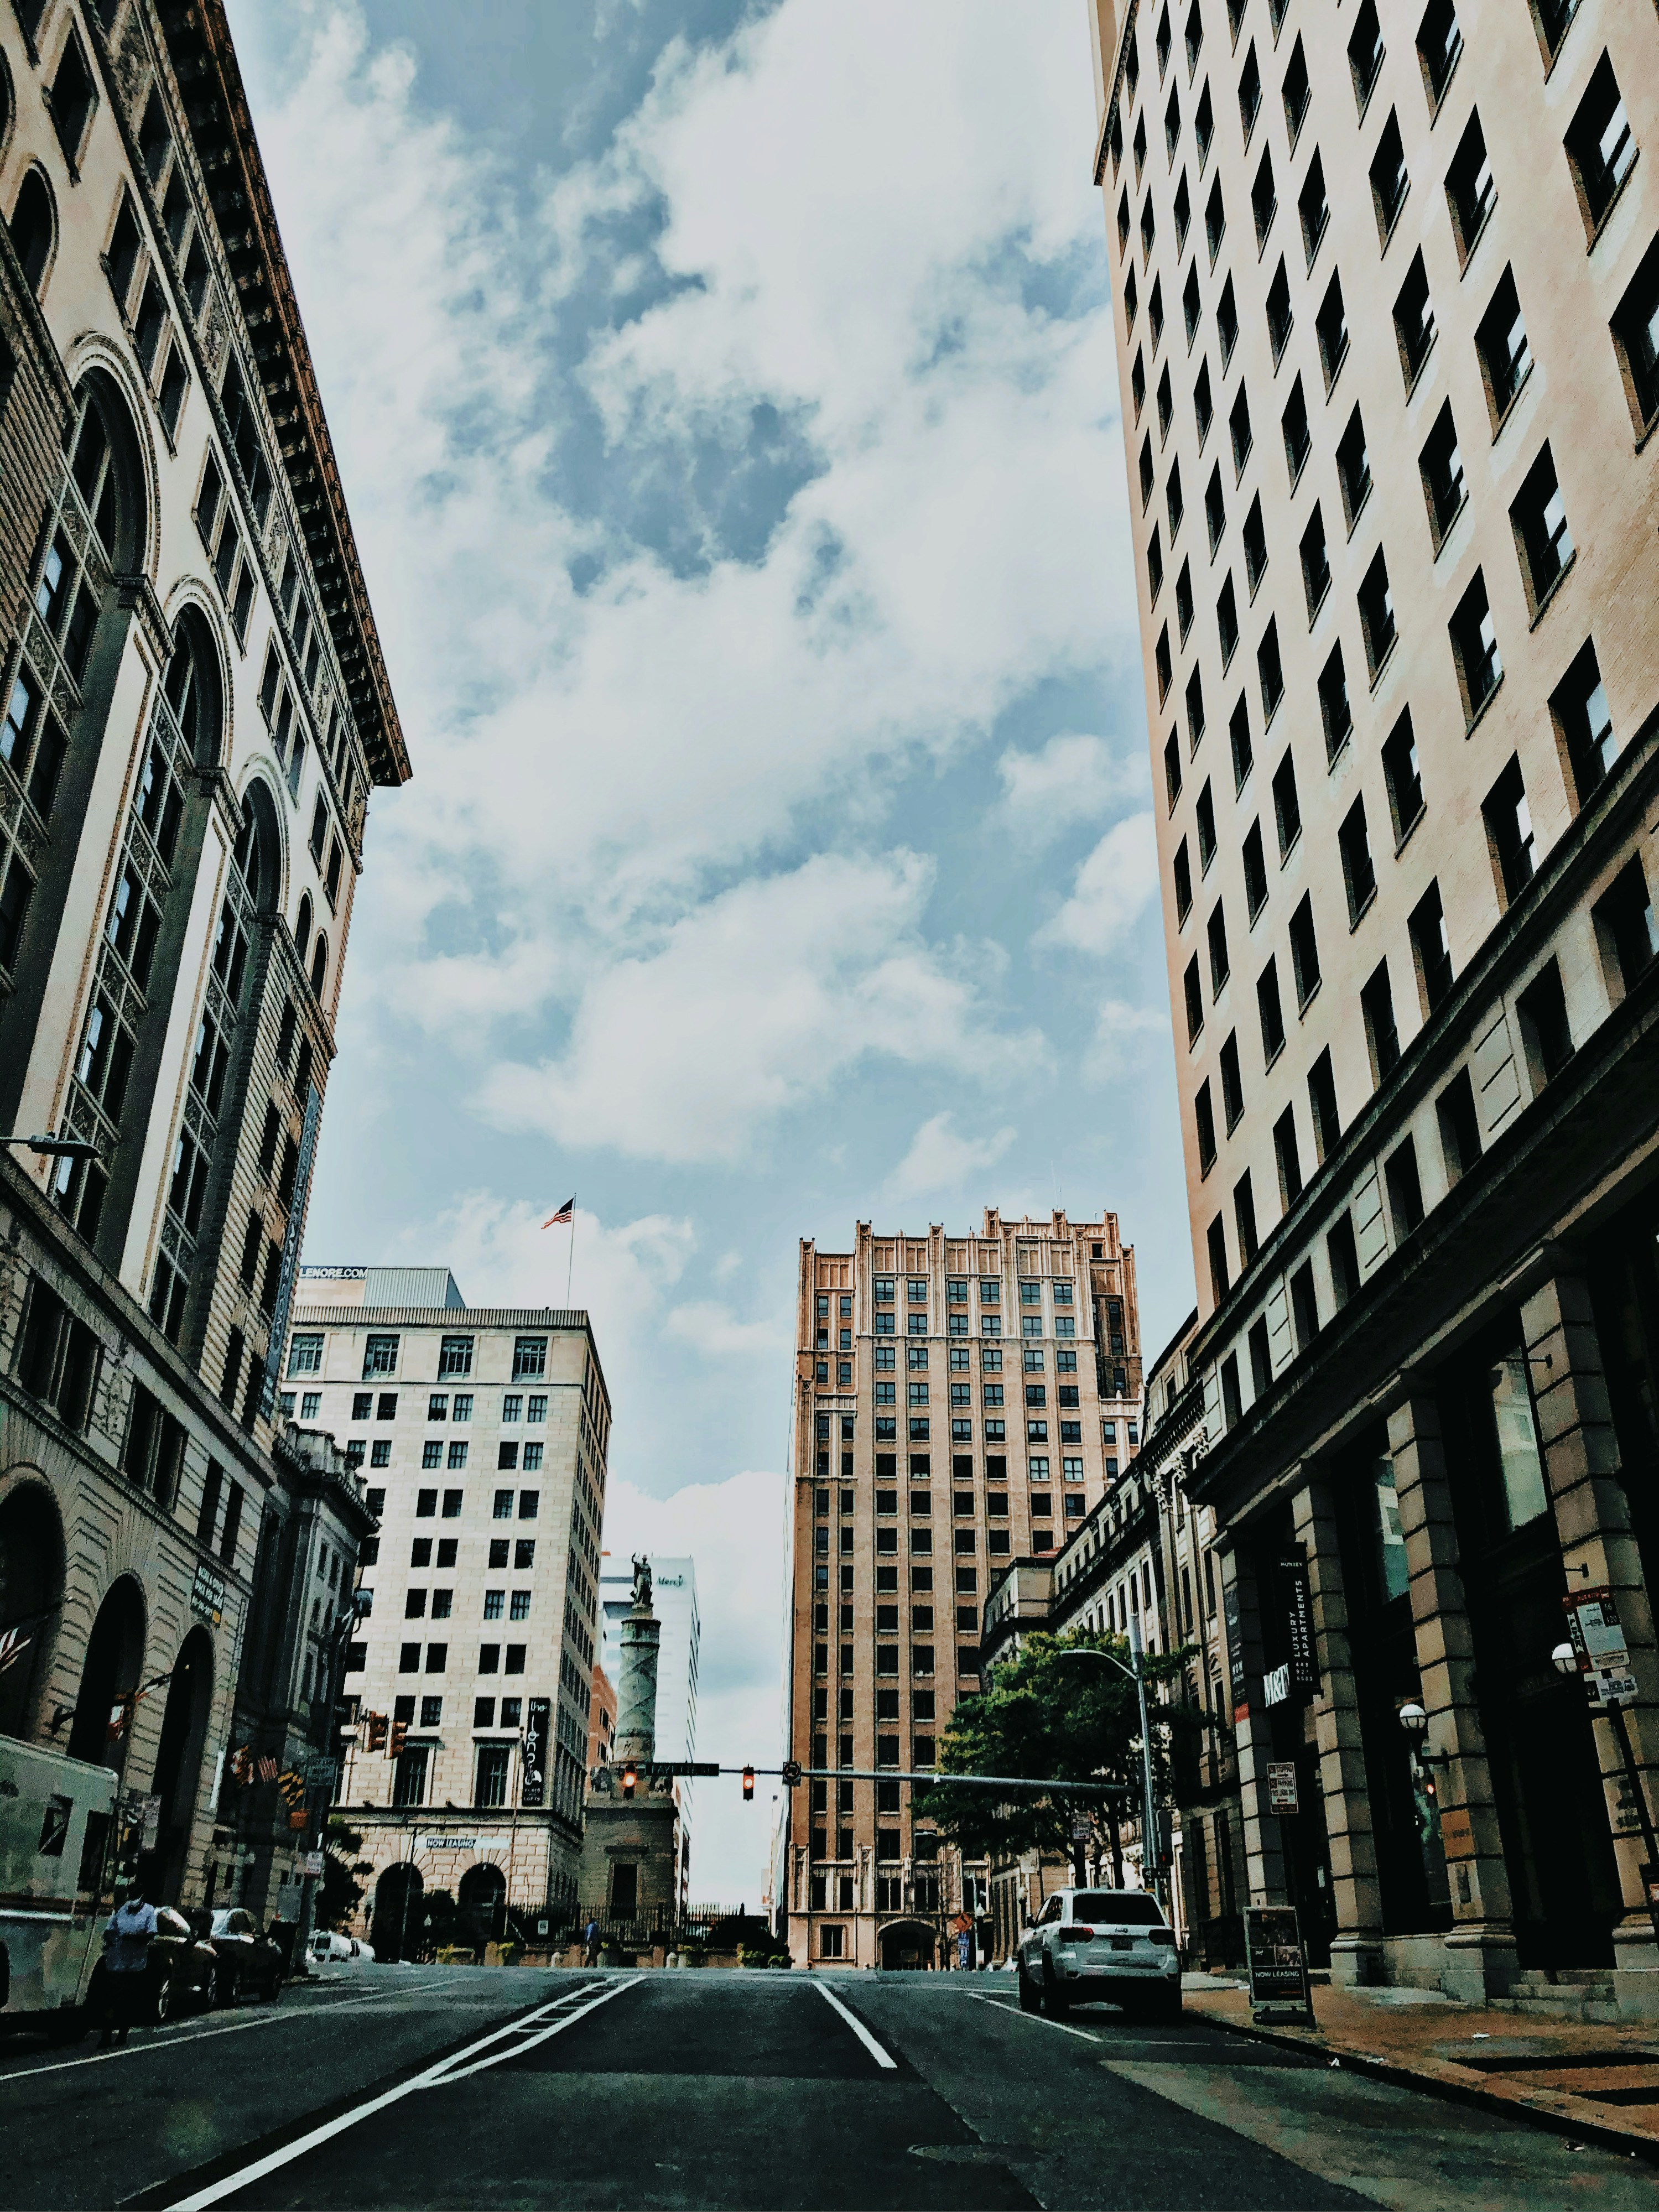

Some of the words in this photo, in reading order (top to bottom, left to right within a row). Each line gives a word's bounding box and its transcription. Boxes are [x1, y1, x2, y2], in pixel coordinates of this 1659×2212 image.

[656, 1575, 684, 1588] Mercy
[1296, 1580, 1310, 1657] APARTMENTS
[1289, 1612, 1301, 1657] LUXURY
[428, 1839, 445, 1848] NOW
[446, 1839, 475, 1848] LEASING
